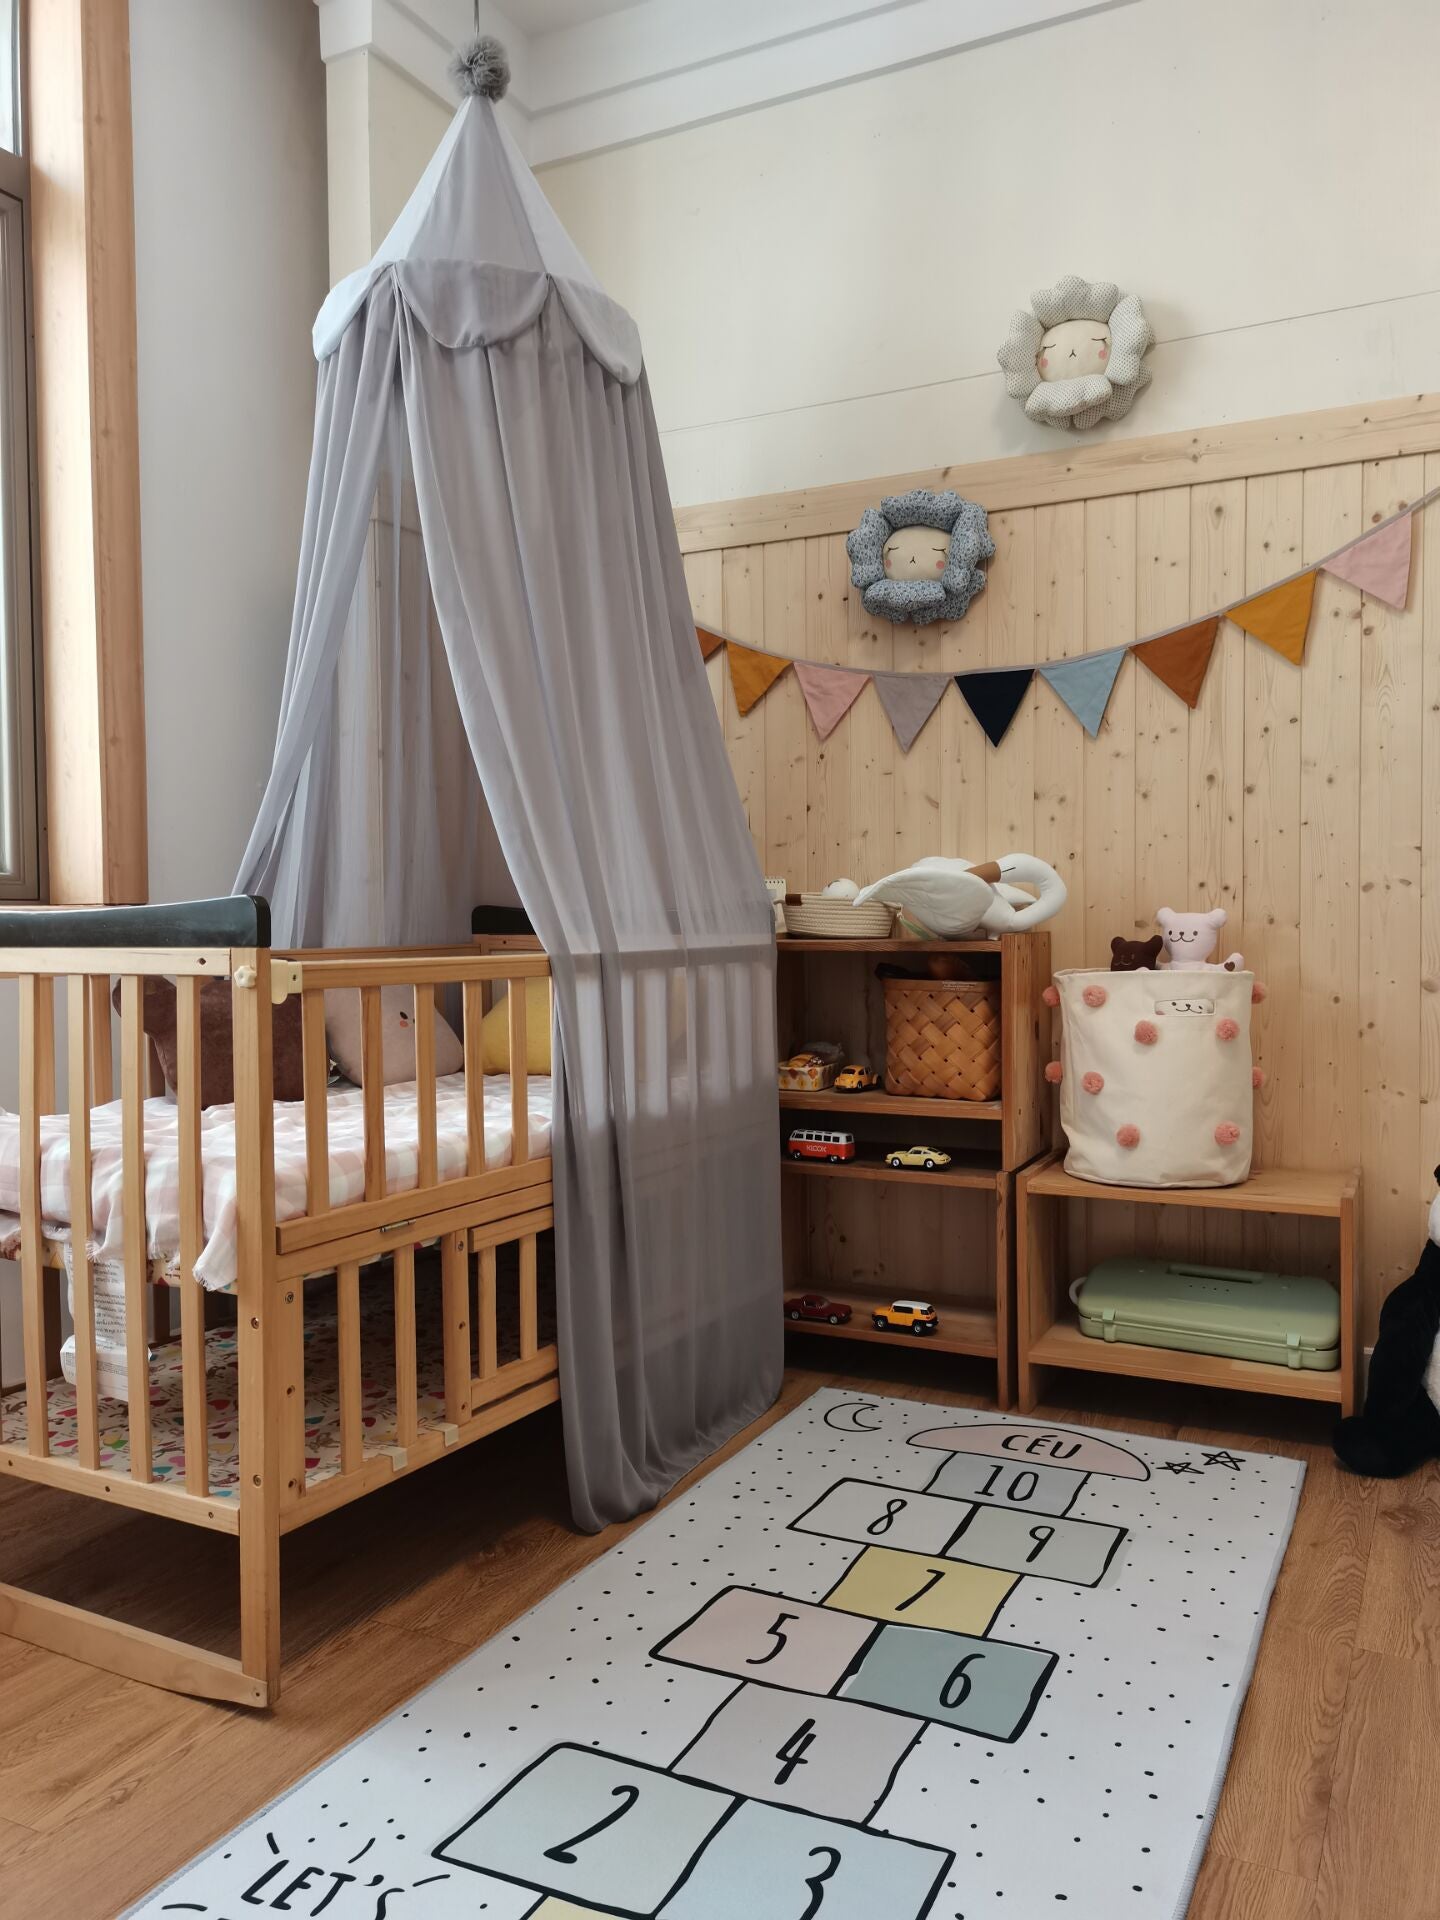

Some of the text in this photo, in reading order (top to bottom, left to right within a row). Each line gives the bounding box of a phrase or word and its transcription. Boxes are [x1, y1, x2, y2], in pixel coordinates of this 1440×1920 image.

[1002, 1433, 1083, 1459] CÉU
[974, 1464, 1040, 1502] 10
[867, 1499, 908, 1536] 8
[1025, 1525, 1056, 1563] 9
[894, 1568, 946, 1612] 7
[745, 1612, 800, 1665] 5
[939, 1653, 986, 1709] 6
[773, 1718, 817, 1786] 4
[542, 1784, 640, 1865] 2
[240, 1859, 405, 1920] LET'S
[799, 1846, 842, 1920] 3
